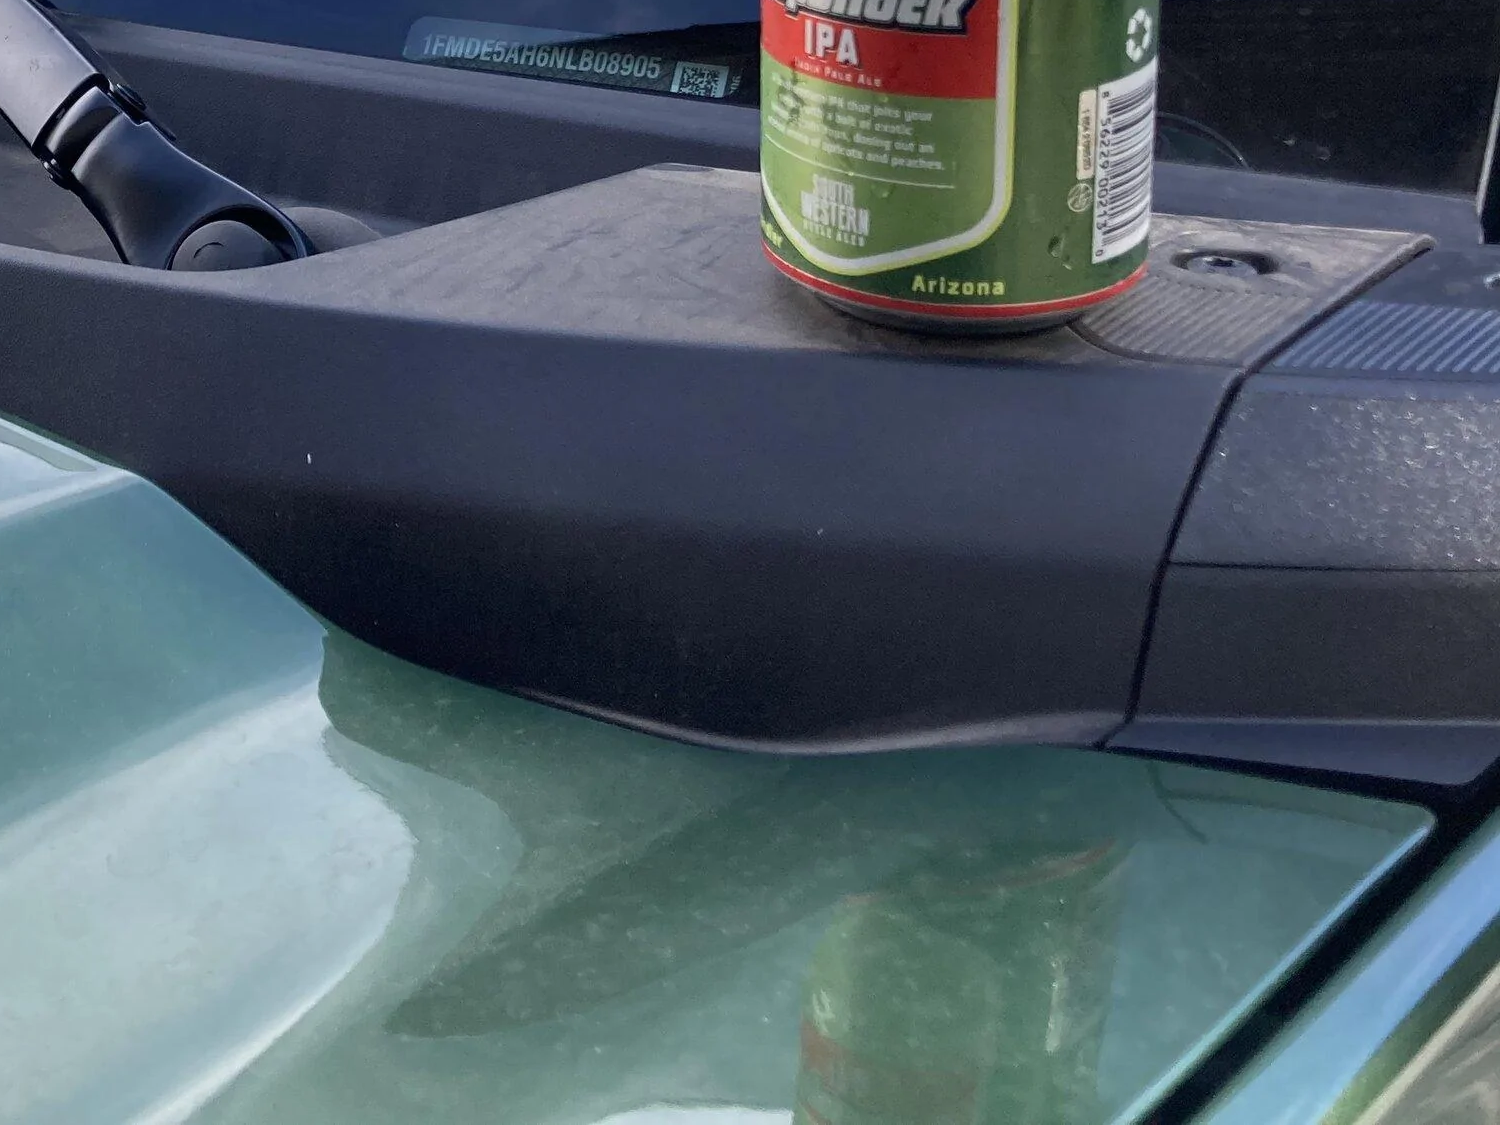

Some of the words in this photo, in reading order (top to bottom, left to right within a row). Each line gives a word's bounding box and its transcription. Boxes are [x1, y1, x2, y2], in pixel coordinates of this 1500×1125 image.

[803, 19, 860, 66] IPA
[1099, 117, 1112, 169] 56229
[1096, 177, 1108, 231] 00213
[911, 275, 1006, 297] Arizona
